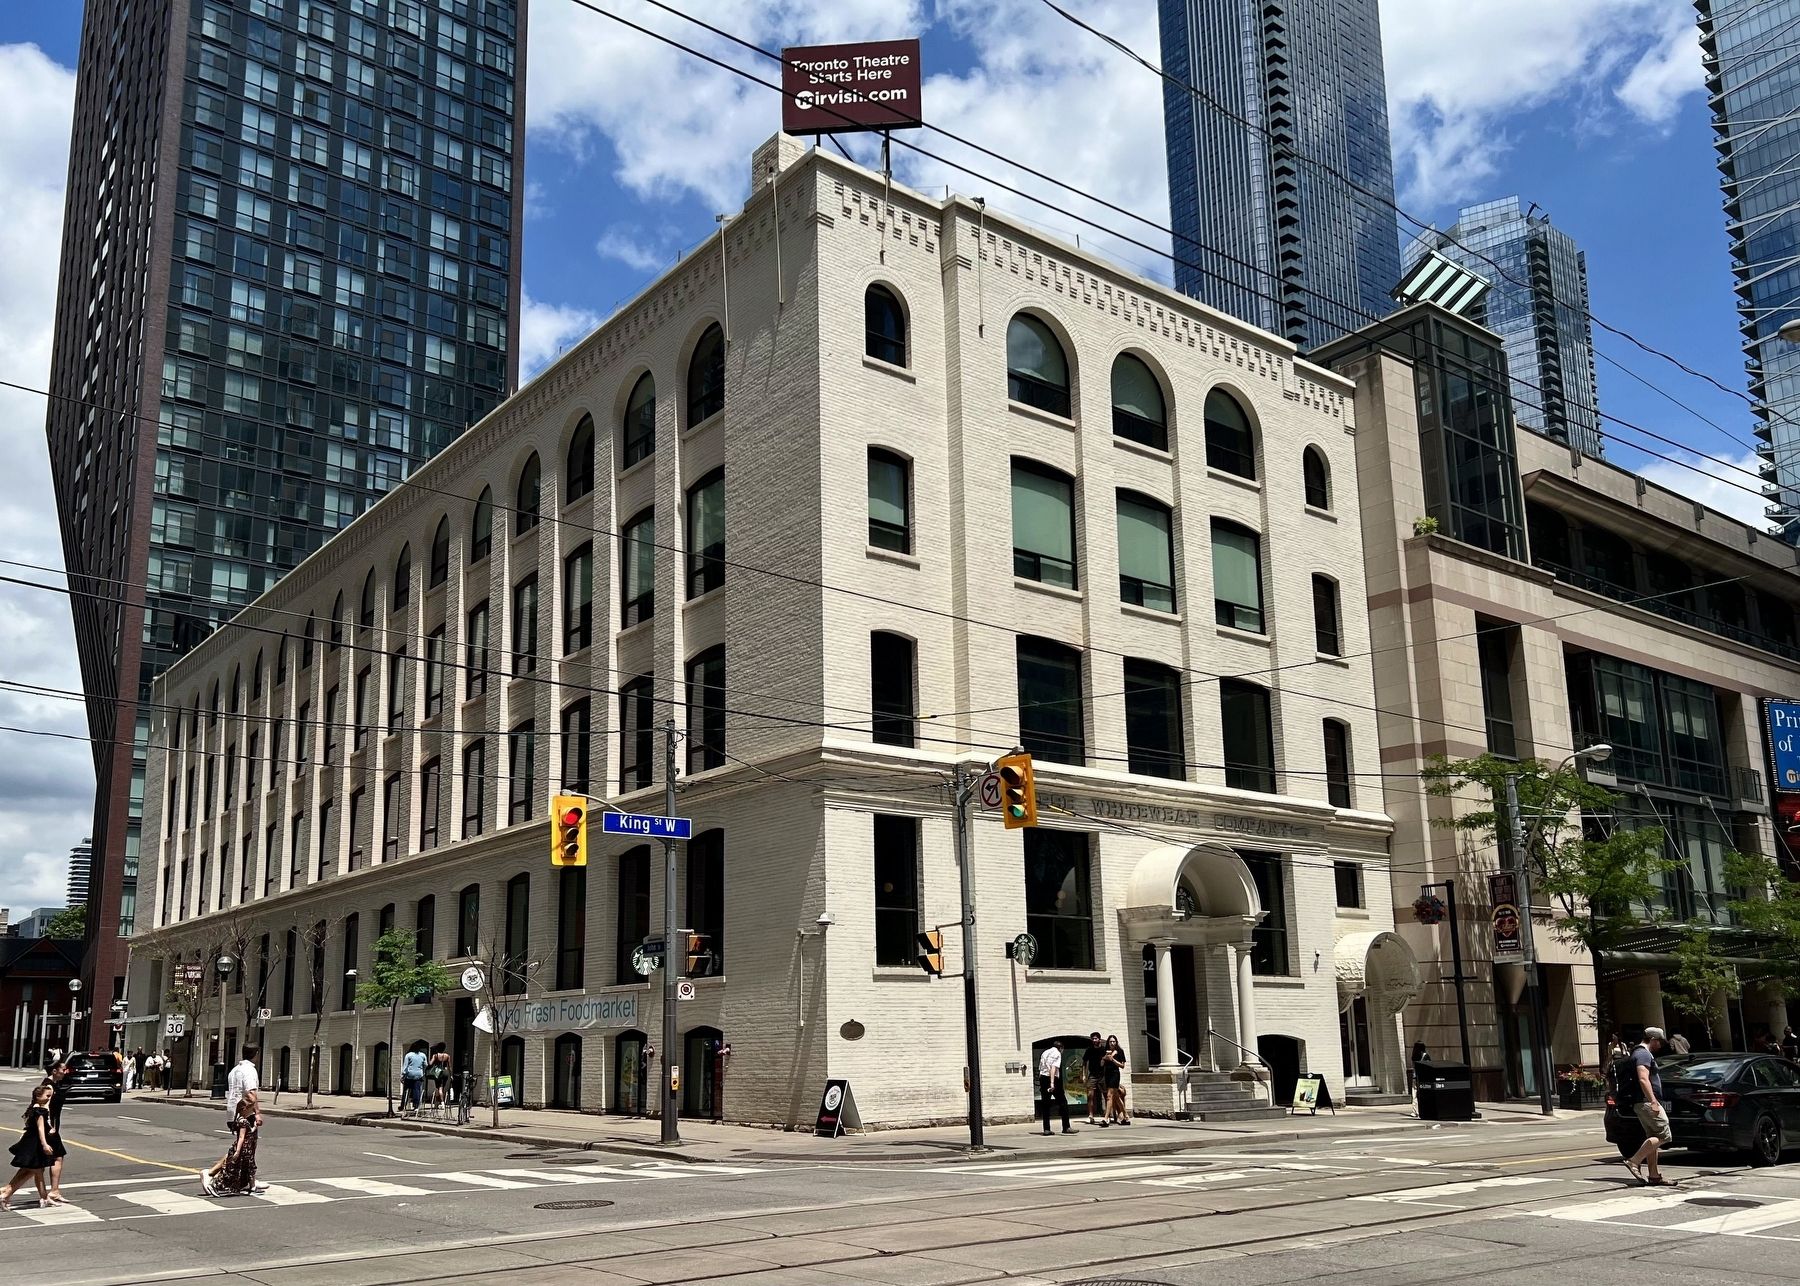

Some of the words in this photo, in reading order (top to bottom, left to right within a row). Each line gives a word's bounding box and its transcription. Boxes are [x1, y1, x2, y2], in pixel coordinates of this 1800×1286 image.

[791, 59, 849, 72] Toronto
[853, 55, 909, 69] Theatre
[809, 71, 853, 84] Starts
[857, 69, 892, 81] Here
[1775, 709, 1800, 729] Pri
[1778, 734, 1793, 752] of
[620, 815, 650, 834] King
[654, 818, 662, 826] St
[665, 819, 676, 832] W
[498, 1005, 521, 1029] Kng
[525, 1002, 556, 1023] Fresh
[560, 995, 636, 1022] Foodmarket
[167, 1023, 183, 1034] 30
